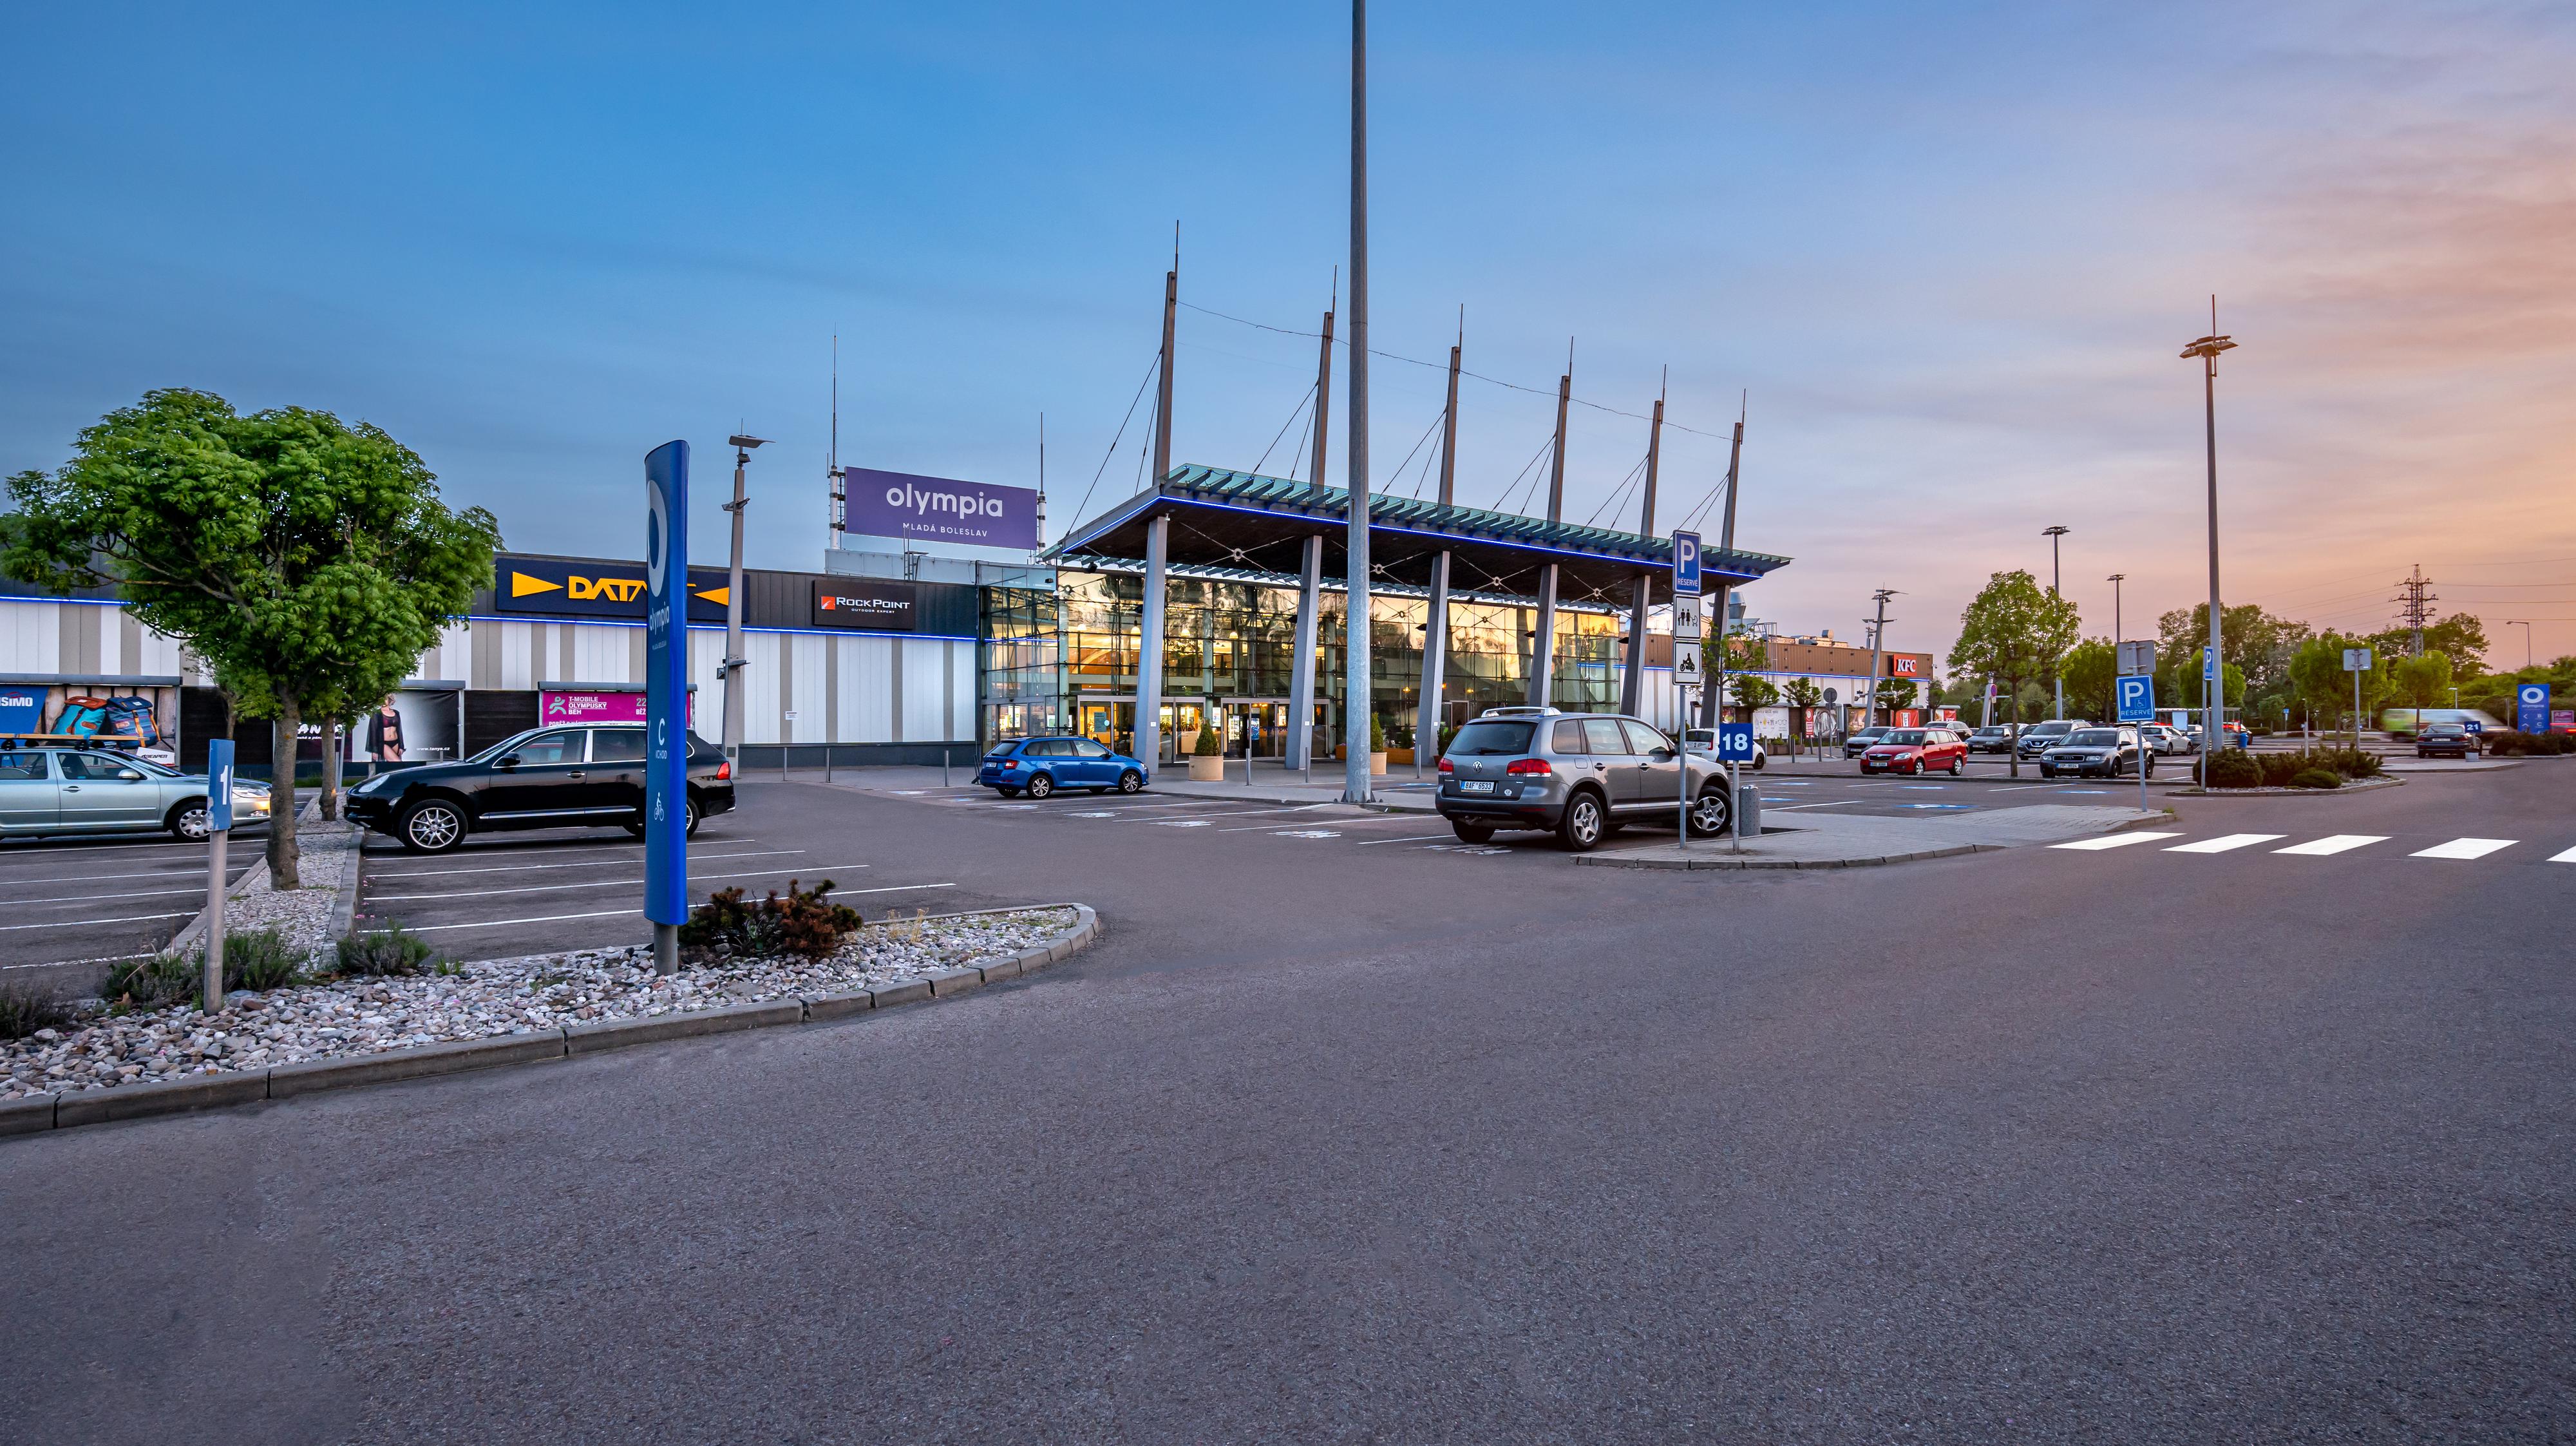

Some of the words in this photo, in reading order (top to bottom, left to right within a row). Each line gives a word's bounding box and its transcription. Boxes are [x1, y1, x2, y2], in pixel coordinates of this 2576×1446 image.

[886, 483, 1003, 519] olympia
[903, 522, 936, 533] MLADÁ
[940, 526, 987, 537] BOLESLAV
[1680, 539, 1695, 573] P
[649, 601, 670, 636] olympia
[1897, 659, 1916, 672] KFC
[2125, 681, 2144, 707] P
[658, 718, 665, 746] C
[1723, 733, 1748, 750] 18
[220, 765, 234, 805] 1
